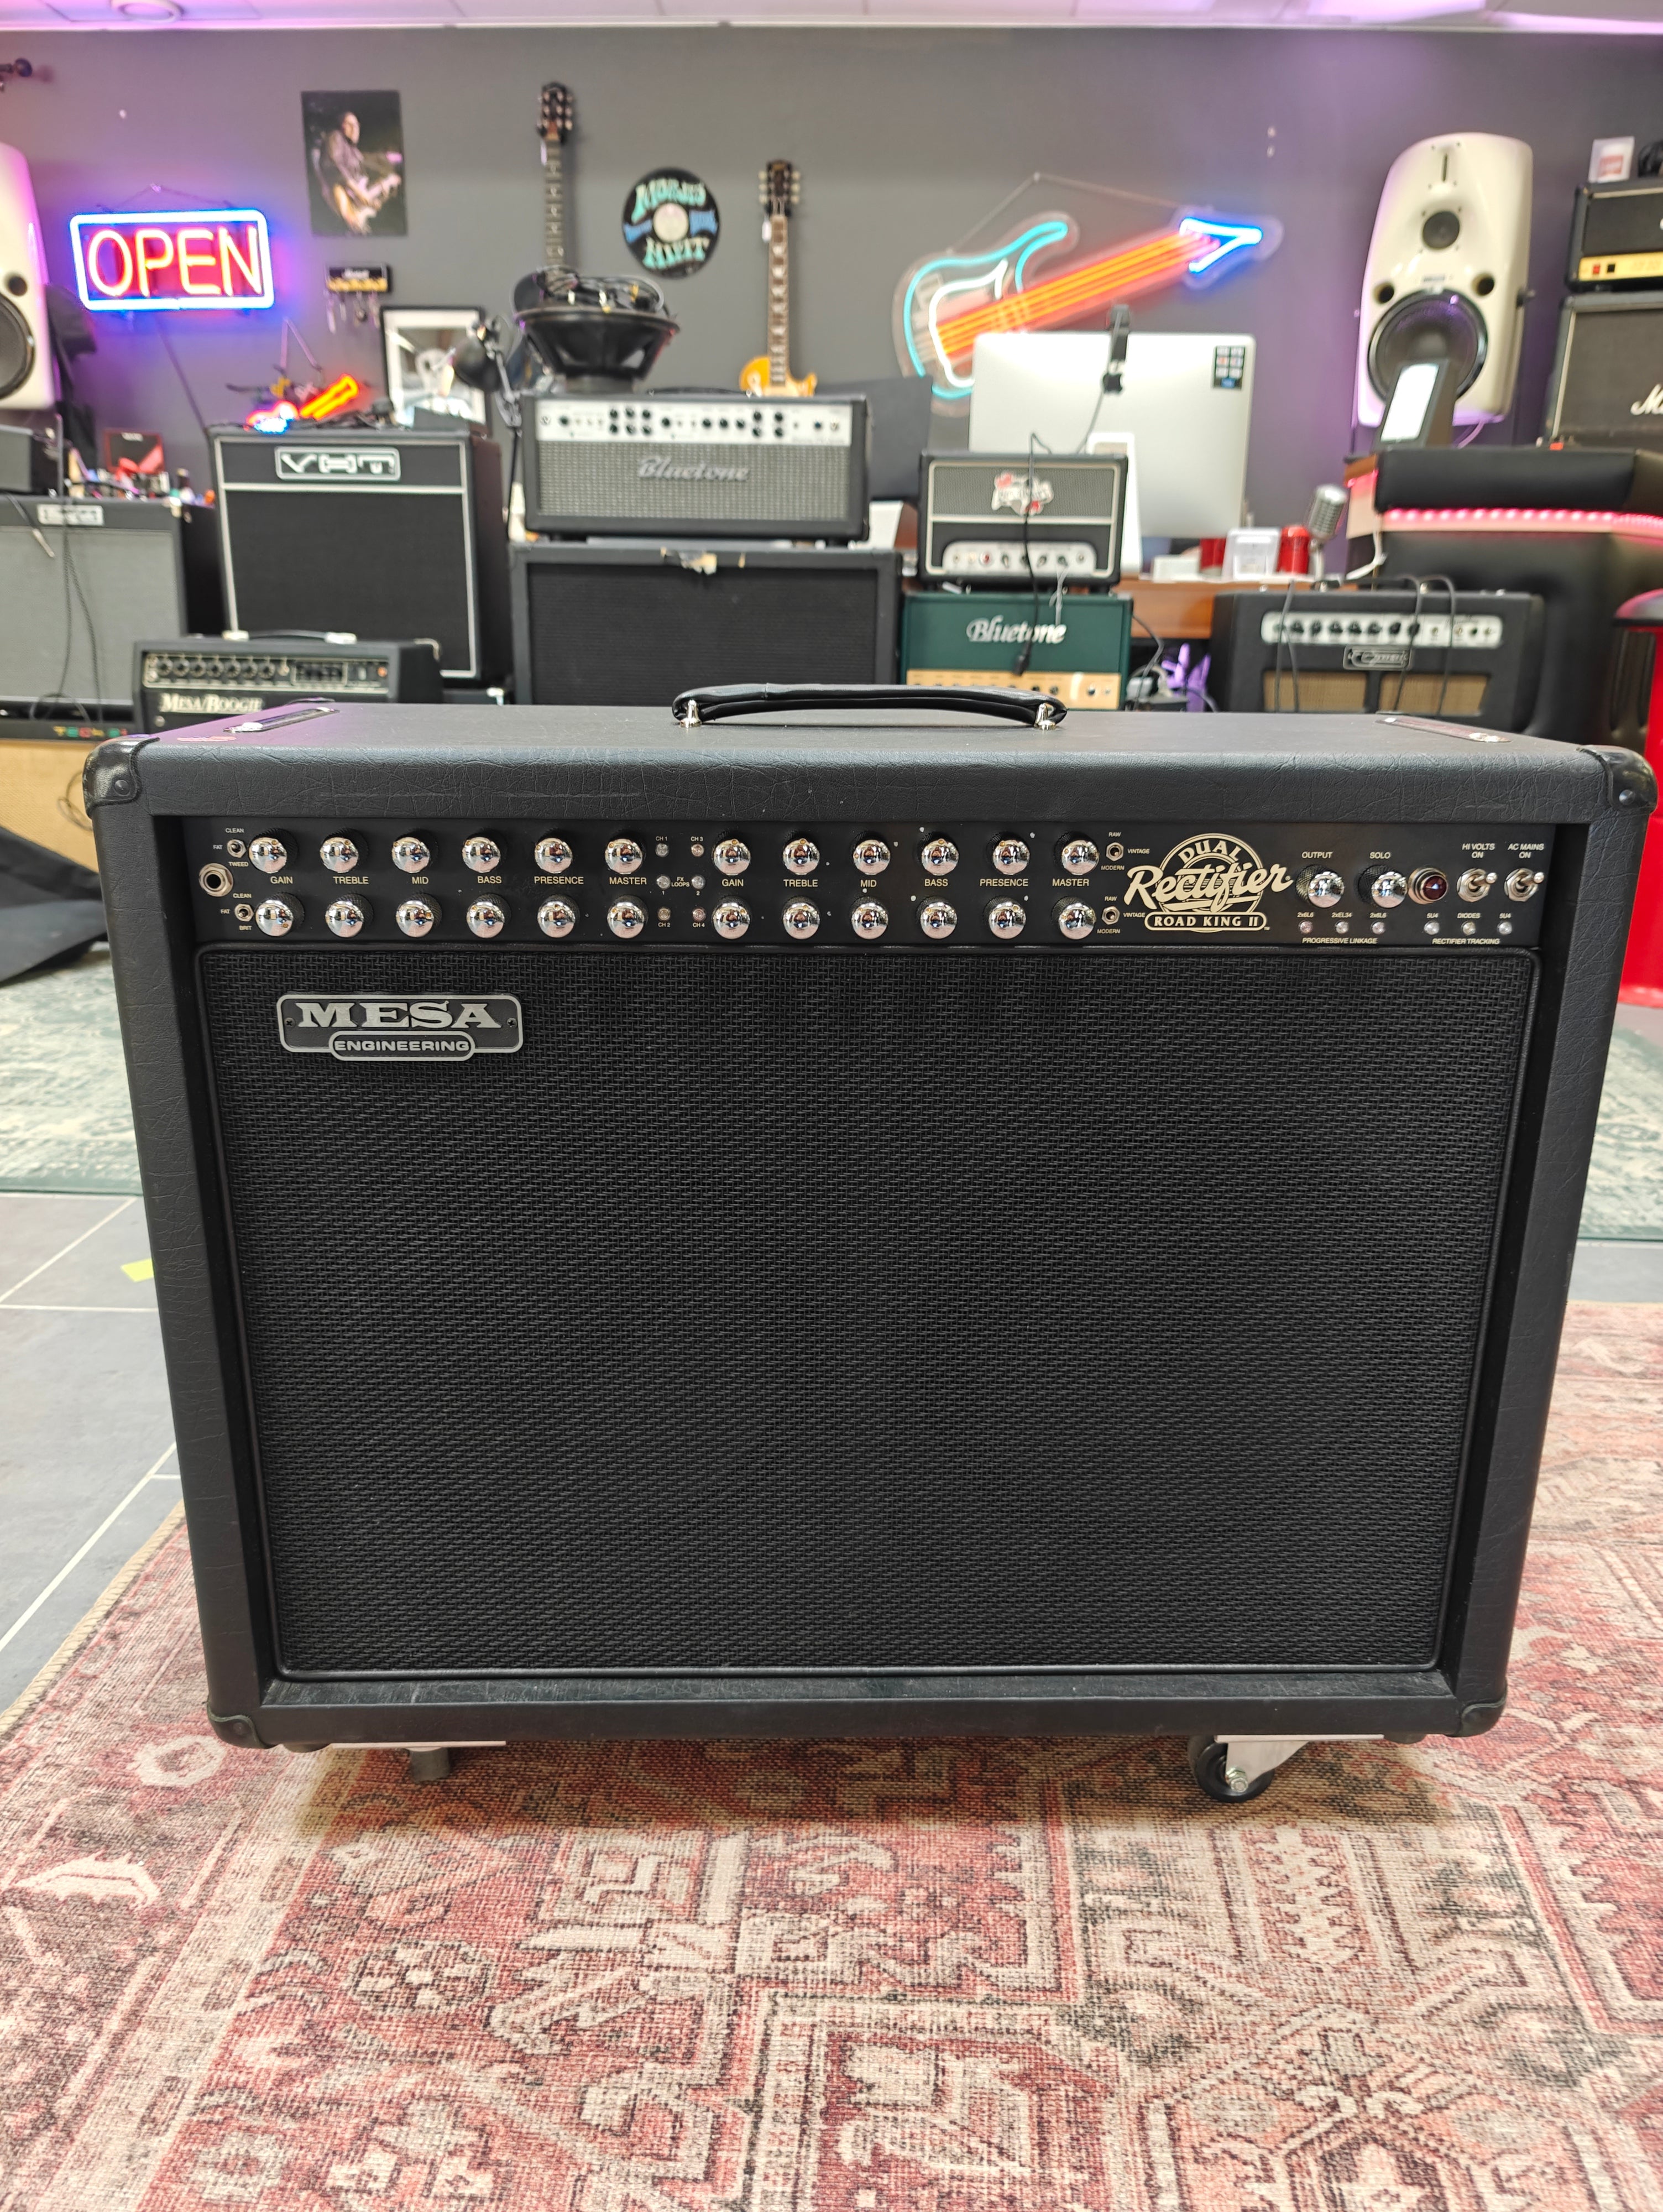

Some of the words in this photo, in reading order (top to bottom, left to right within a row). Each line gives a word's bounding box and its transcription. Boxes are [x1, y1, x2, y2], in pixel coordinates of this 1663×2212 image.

[87, 225, 263, 297] OPEN
[281, 453, 395, 474] VHT
[1178, 840, 1242, 864] DUAL
[270, 876, 294, 884] GAIN
[333, 876, 369, 884] TREBLE
[411, 876, 429, 884] MID
[534, 876, 584, 884] PRESENCE
[609, 877, 647, 885] MASTER
[721, 878, 744, 887] GAIN
[860, 879, 877, 888] MID
[980, 878, 1029, 886] PRESENCE
[1154, 916, 1196, 927] ROAD
[1203, 916, 1241, 927] KING
[1248, 916, 1258, 926] II
[295, 1000, 501, 1029] MESA
[334, 1040, 470, 1051] ENGINEERING
